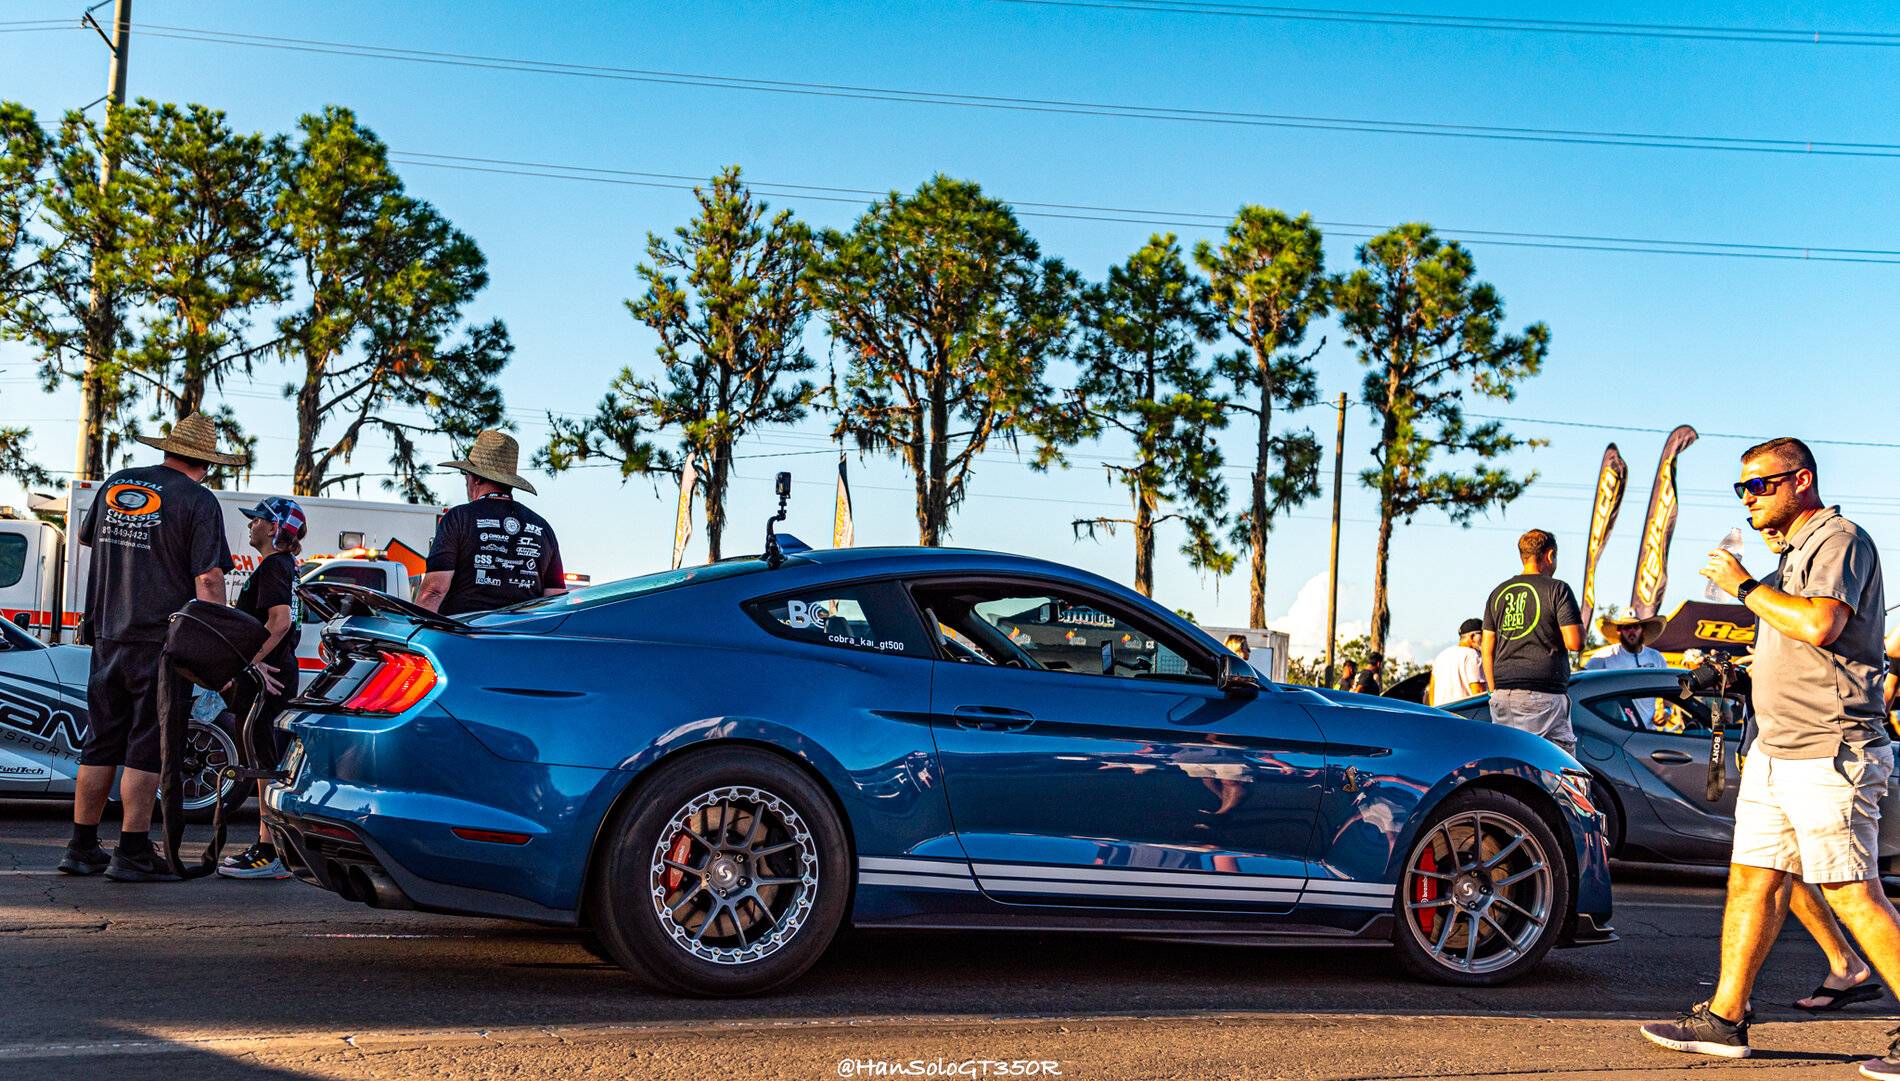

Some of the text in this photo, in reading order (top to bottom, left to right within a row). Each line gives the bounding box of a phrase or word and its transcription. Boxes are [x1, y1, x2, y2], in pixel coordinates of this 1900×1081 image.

[107, 479, 163, 491] COASTAL
[105, 515, 161, 528] DYNO
[107, 509, 160, 521] CHASSIS
[474, 555, 492, 565] CSS
[828, 635, 904, 650] cobra_kai_gt500
[0, 728, 81, 766] SPORTS
[1712, 736, 1721, 763] SONY
